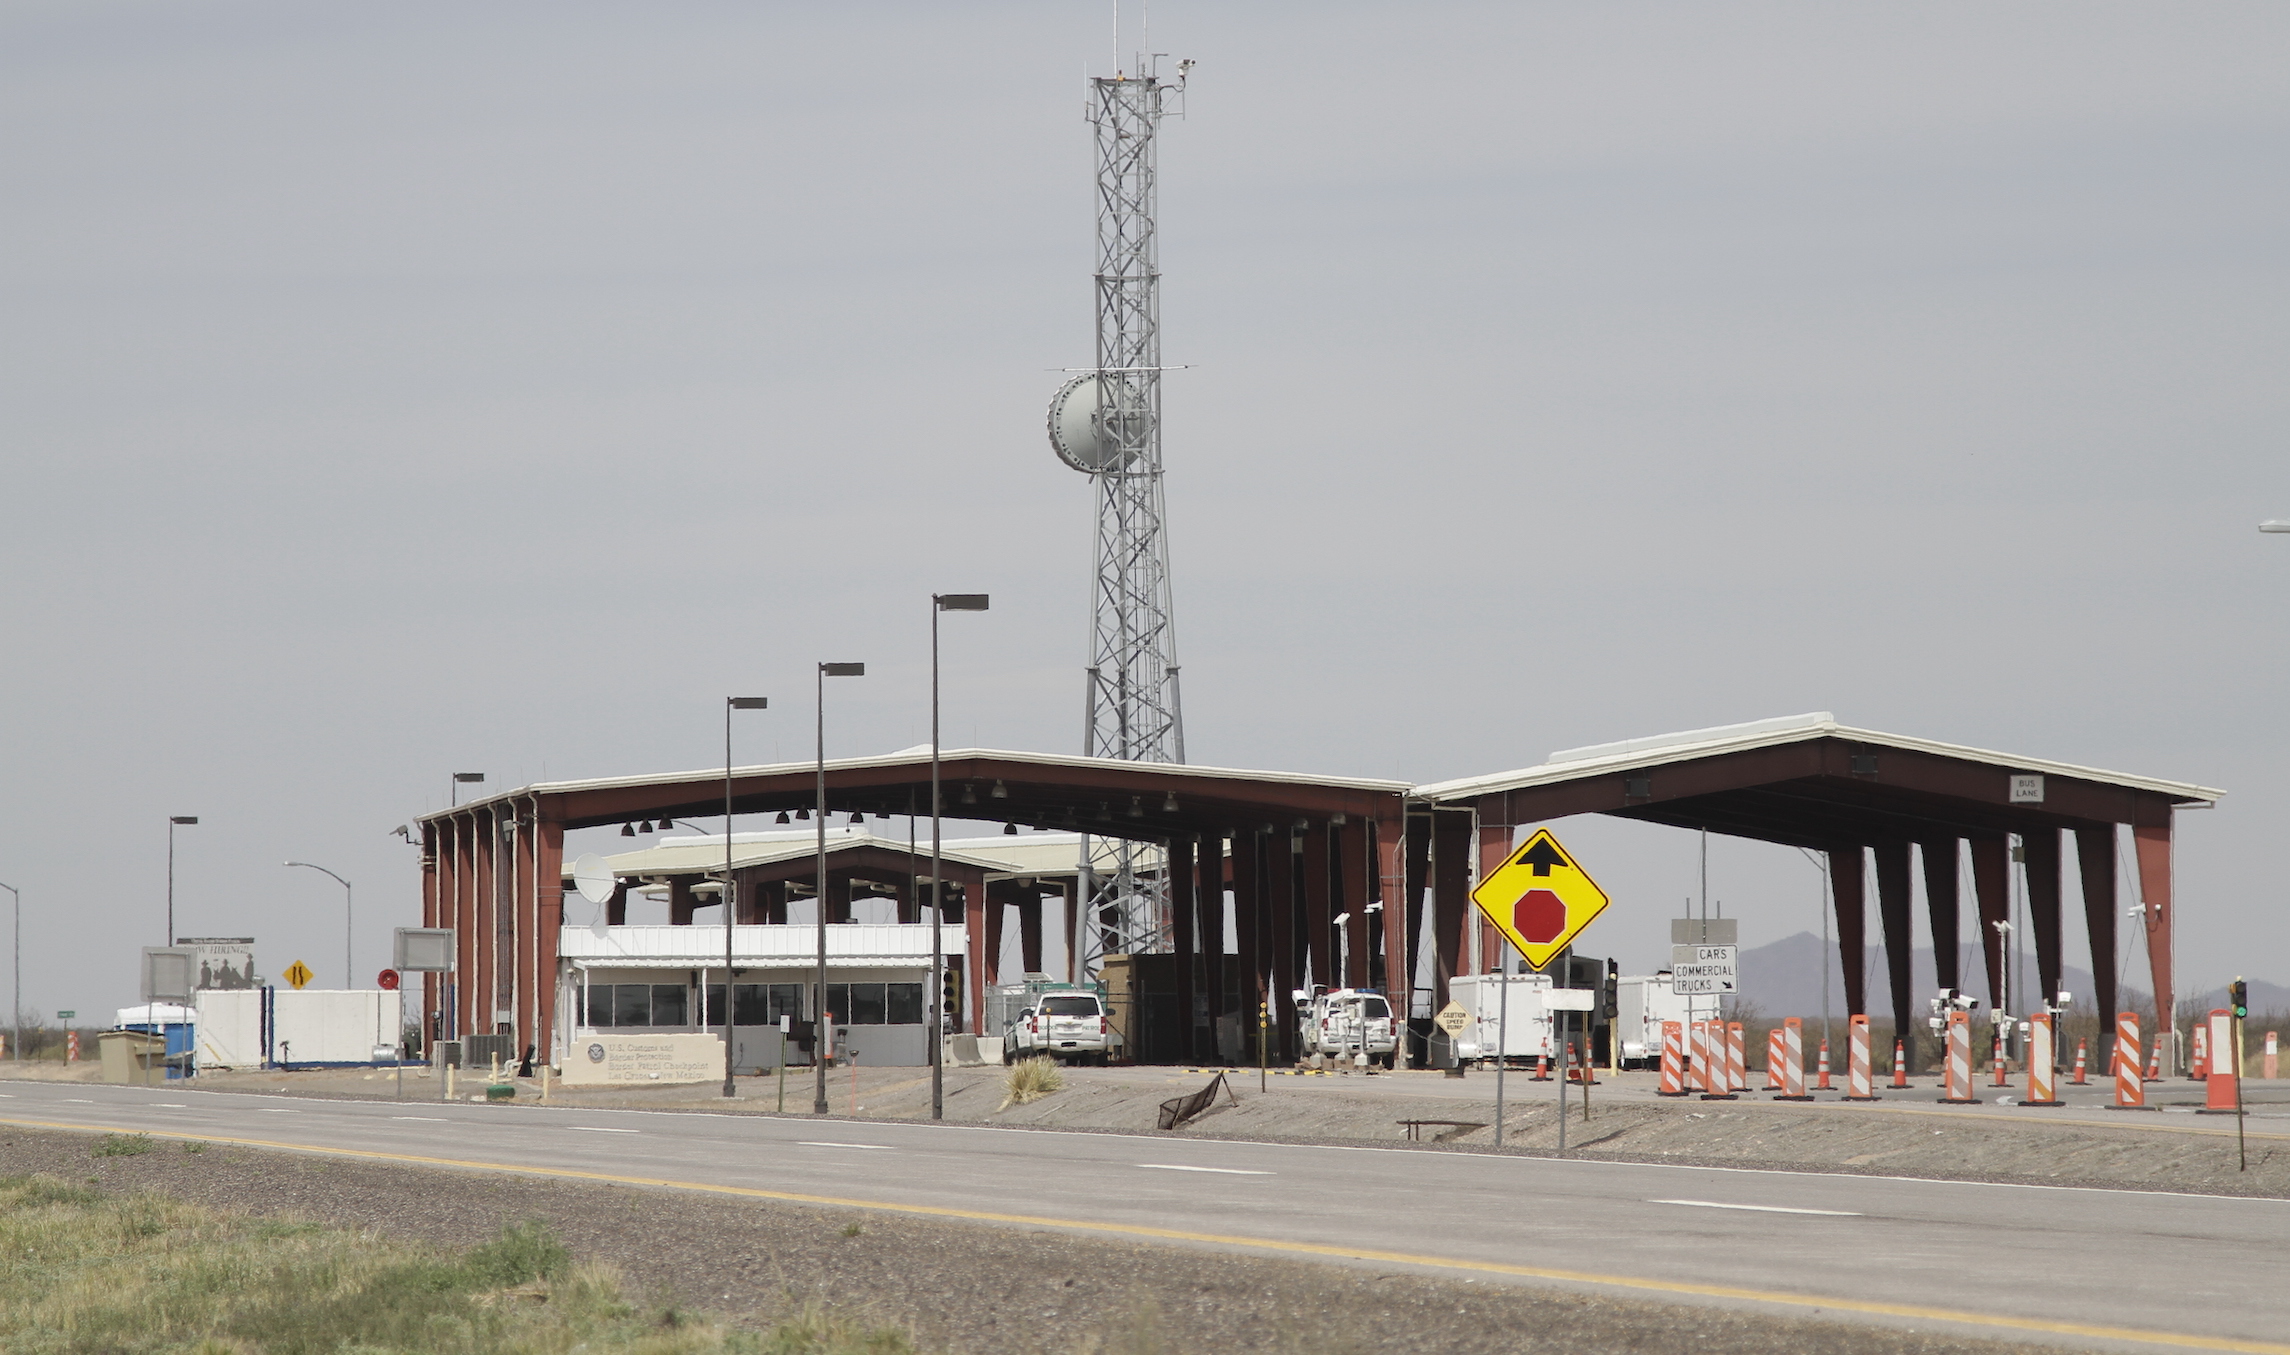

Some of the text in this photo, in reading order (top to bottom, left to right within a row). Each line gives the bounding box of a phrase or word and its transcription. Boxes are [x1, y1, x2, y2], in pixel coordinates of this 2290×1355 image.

[2019, 780, 2036, 788] BUS
[1699, 948, 1727, 960] CARS
[1676, 965, 1734, 977] COMMERCIAL
[1676, 979, 1712, 992] TRUCKS
[608, 1043, 625, 1052] U.S.
[627, 1043, 658, 1052] Customs
[608, 1052, 673, 1062] Border Protection
[608, 1061, 709, 1071] Border Patrol Checkpoint
[675, 1071, 705, 1080] Mexico
